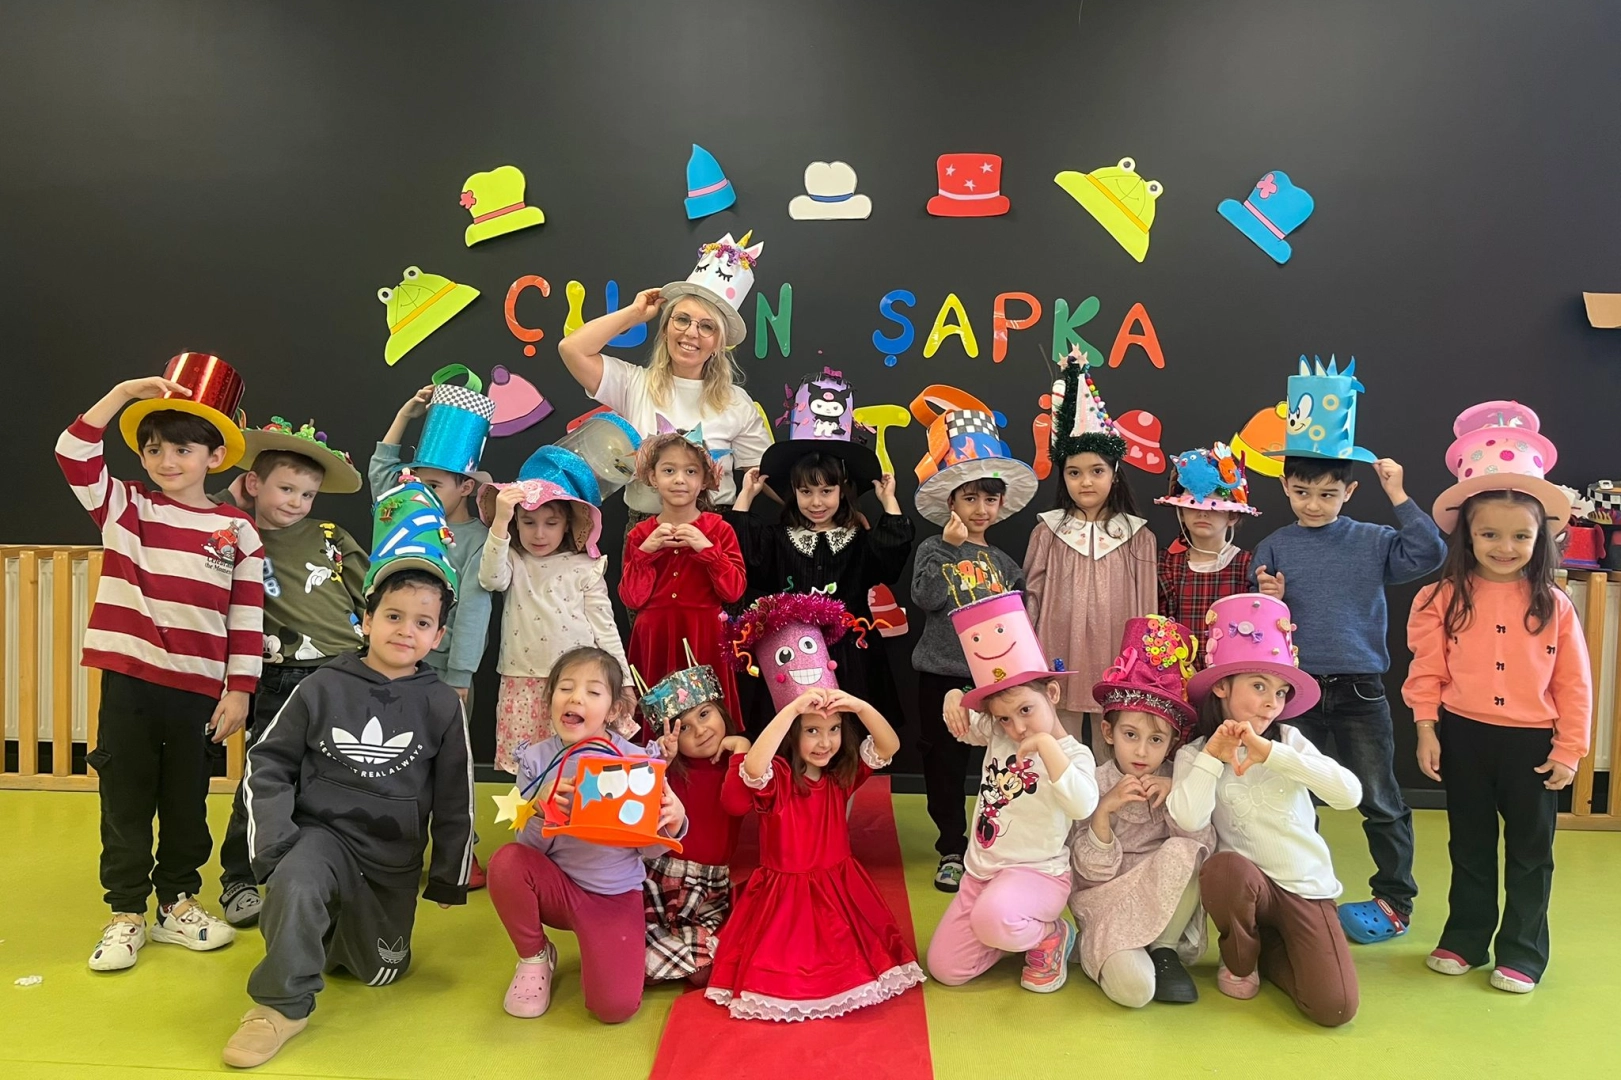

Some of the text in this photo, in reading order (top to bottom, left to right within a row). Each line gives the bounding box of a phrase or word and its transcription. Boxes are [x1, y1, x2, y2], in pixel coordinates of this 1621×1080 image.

[504, 274, 1166, 369] ÇILN ŞAPKA
[360, 770, 387, 778] REAL
[389, 743, 423, 775] ALWAYS
